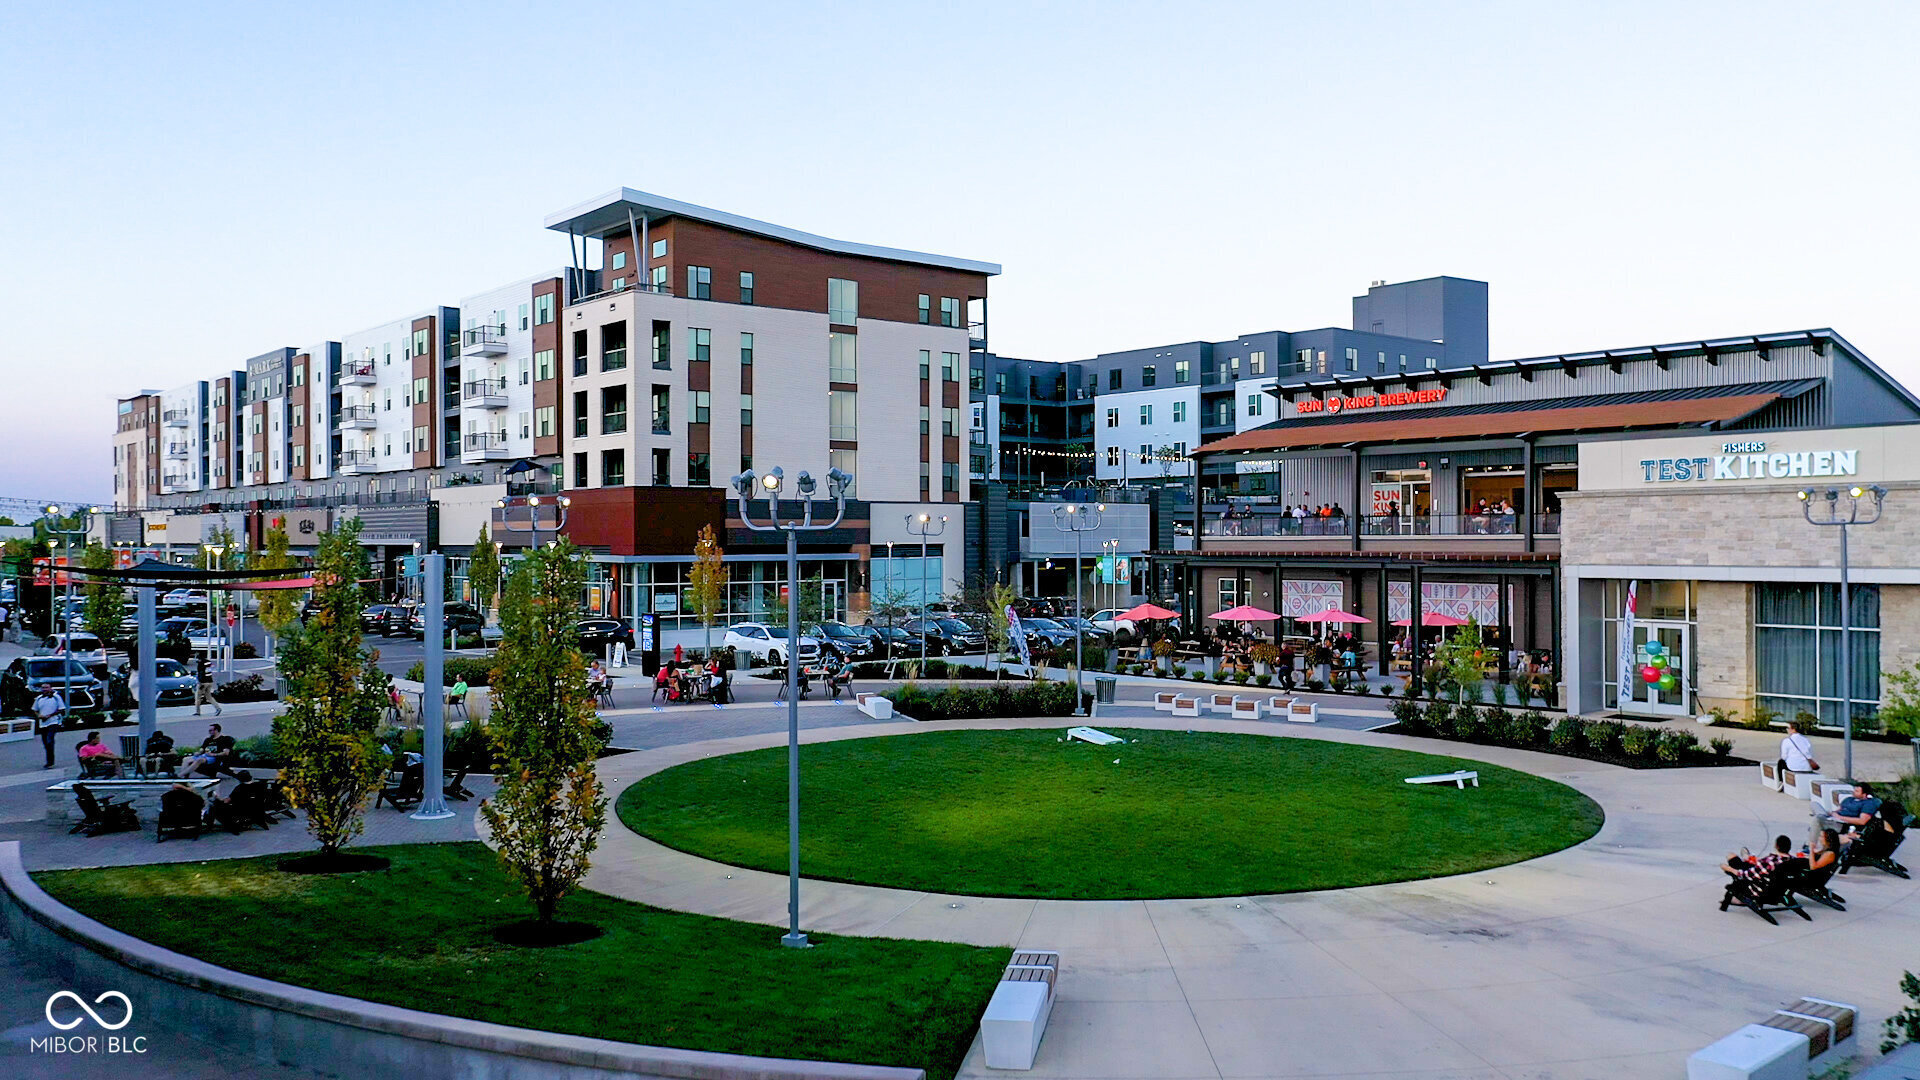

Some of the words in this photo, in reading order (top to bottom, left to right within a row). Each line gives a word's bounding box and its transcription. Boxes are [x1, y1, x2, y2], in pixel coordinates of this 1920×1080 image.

[1297, 400, 1323, 413] SUN
[1343, 395, 1376, 410] KING
[1379, 389, 1447, 407] BREWERY
[1722, 441, 1765, 454] FISHERS
[1640, 457, 1708, 482] TEST
[1712, 450, 1858, 480] KITCHEN
[1374, 490, 1400, 501] SUN
